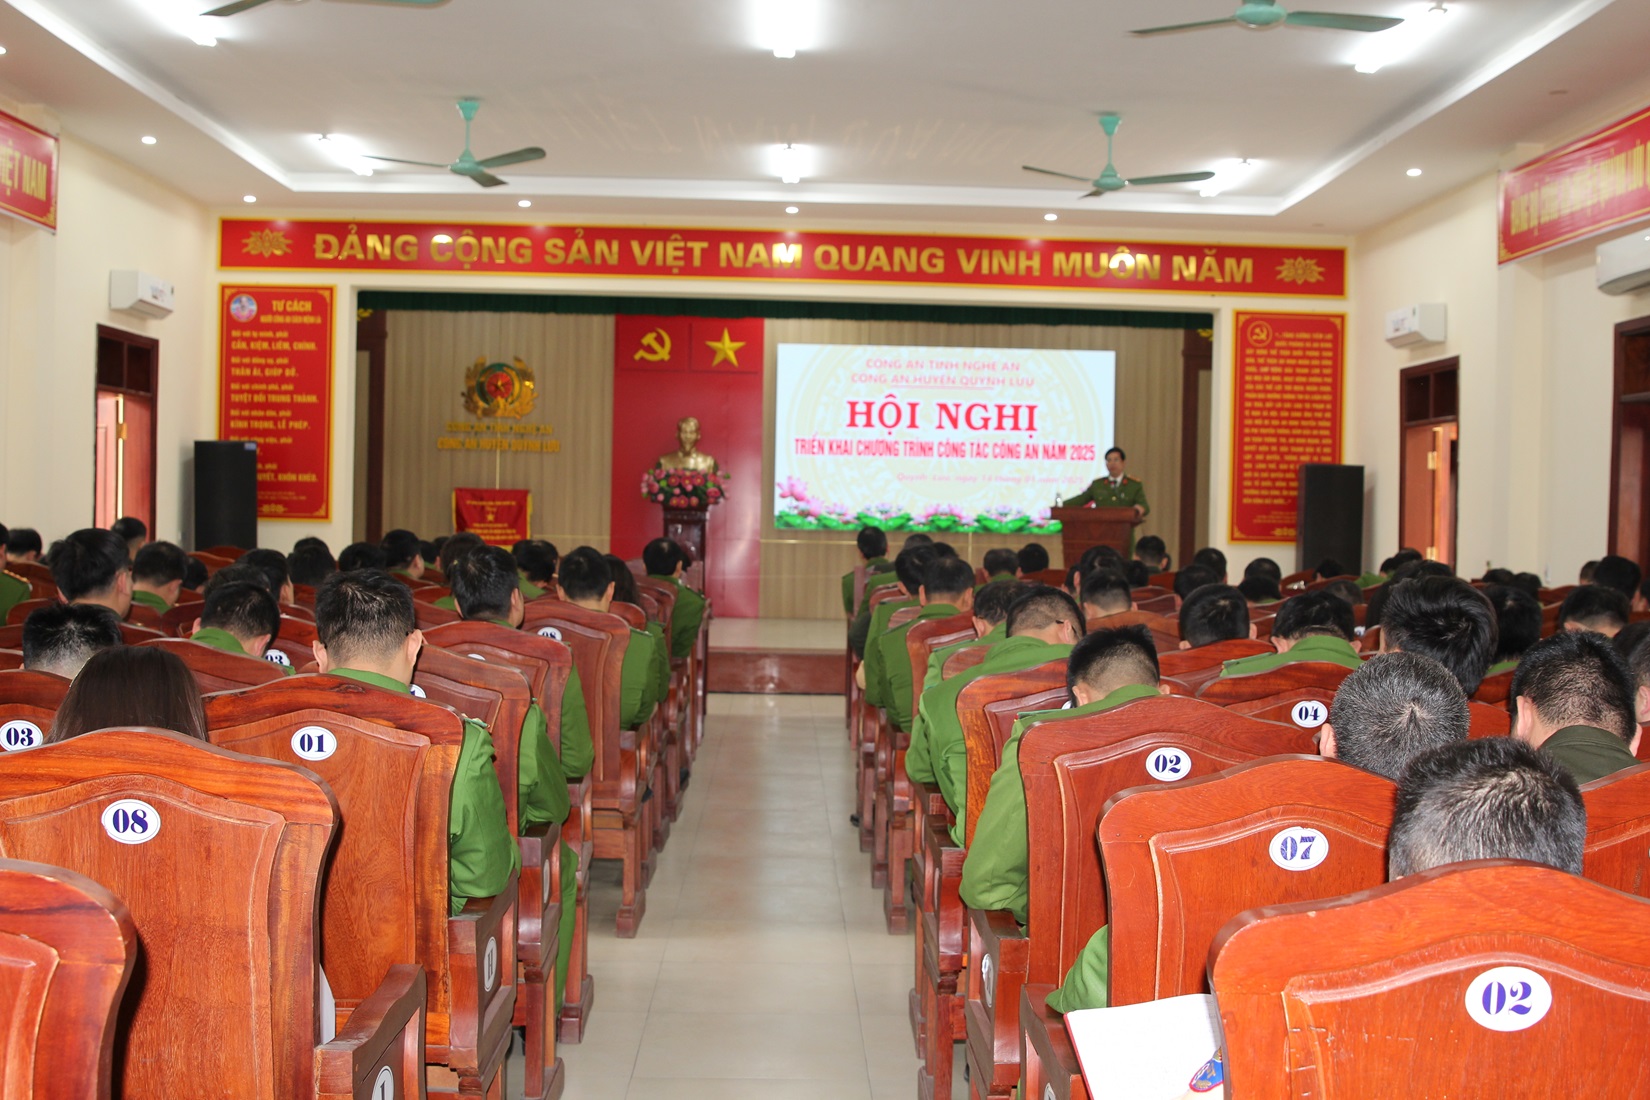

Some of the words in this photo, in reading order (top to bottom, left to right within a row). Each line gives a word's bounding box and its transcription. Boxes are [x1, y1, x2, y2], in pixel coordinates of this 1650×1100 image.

[0, 138, 21, 197] IỆT
[22, 154, 47, 202] NAM
[313, 224, 419, 262] ĐẢNG
[429, 228, 533, 270] CỘNG
[544, 228, 620, 267] SẢN
[630, 234, 709, 274] VIỆT
[718, 239, 803, 270] NAM
[813, 243, 945, 275] QUANG
[956, 248, 1042, 277] VINH
[1052, 246, 1161, 281] MUÔN
[1171, 247, 1254, 284] NĂM
[272, 299, 286, 312] TƯ
[286, 298, 312, 312] CÁCH
[906, 360, 924, 371] AN
[1002, 361, 1020, 372] AN
[891, 373, 910, 385] AN
[846, 394, 920, 435] HỘI
[936, 403, 1038, 438] NGHỊ
[828, 438, 853, 456] KHAI
[937, 439, 966, 458] CÔNG
[970, 440, 989, 458] TÁC
[992, 440, 1021, 460] CÔNG
[1024, 443, 1039, 460] AN
[1042, 441, 1067, 460] NĂM
[1070, 444, 1095, 461] 2025
[1298, 706, 1320, 722] 04
[6, 727, 34, 747] 03
[300, 733, 325, 753] 01
[1154, 754, 1182, 774] 02
[112, 808, 148, 835] 08
[1280, 836, 1317, 861] 07
[1481, 981, 1533, 1016] 02
